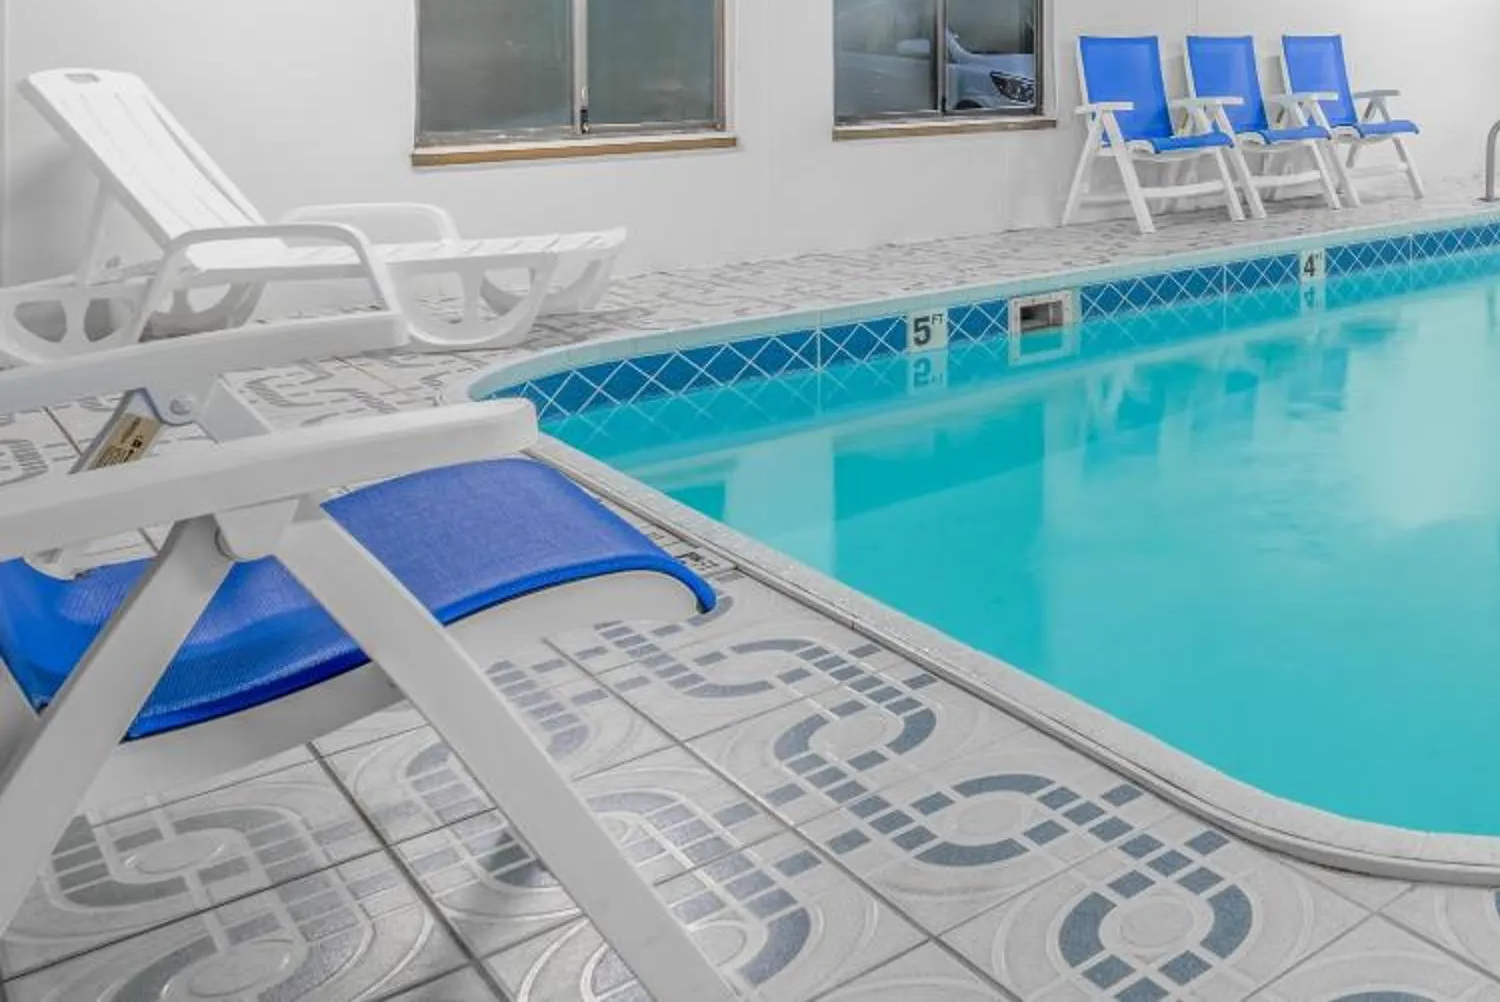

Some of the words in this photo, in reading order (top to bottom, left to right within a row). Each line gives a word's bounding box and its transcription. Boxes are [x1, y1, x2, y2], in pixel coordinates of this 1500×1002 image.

[1303, 253, 1316, 277] 4
[913, 316, 931, 346] 5
[931, 313, 944, 325] FT
